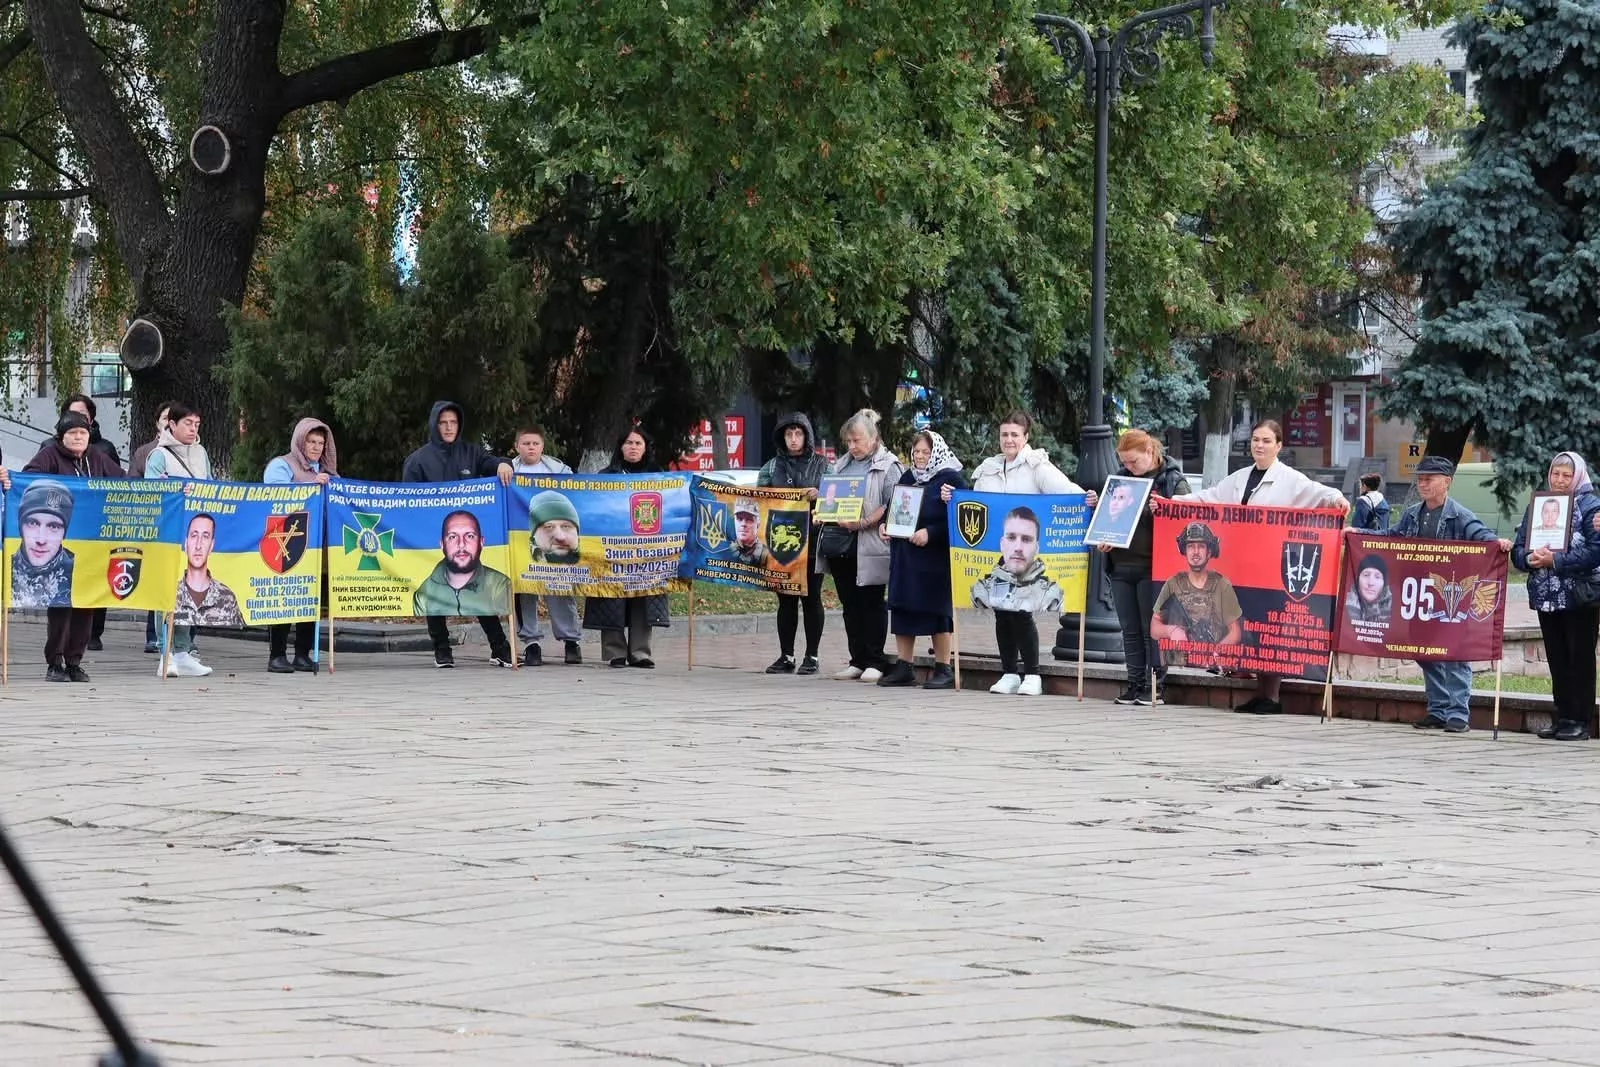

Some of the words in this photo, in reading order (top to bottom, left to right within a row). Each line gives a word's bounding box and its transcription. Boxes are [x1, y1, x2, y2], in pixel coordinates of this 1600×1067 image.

[516, 475, 532, 487] Ми
[534, 477, 558, 489] тебе
[345, 484, 368, 494] ТЕБЕ
[438, 482, 496, 496] ЗНАЙДЕМО!
[372, 499, 407, 509] ВАДИМ
[408, 495, 496, 509] ОЛЕКСАНДРОВИЧ
[1052, 515, 1084, 526] Андрій
[1221, 507, 1264, 524] ДЕНИС
[100, 525, 113, 538] 30
[115, 526, 159, 540] БРИГАДА
[1047, 539, 1083, 547] «Малюк
[1390, 543, 1417, 551] ПАВЛО
[1418, 544, 1486, 554] ОЛЕКСАНДРОВИЧ
[605, 548, 634, 559] Зник
[707, 559, 729, 568] ЗНИК
[696, 569, 731, 579] ЖИВЕМО
[1401, 577, 1435, 621] 95
[1160, 638, 1176, 650] Ми
[1386, 644, 1418, 653] ЧЕКАЄМО
